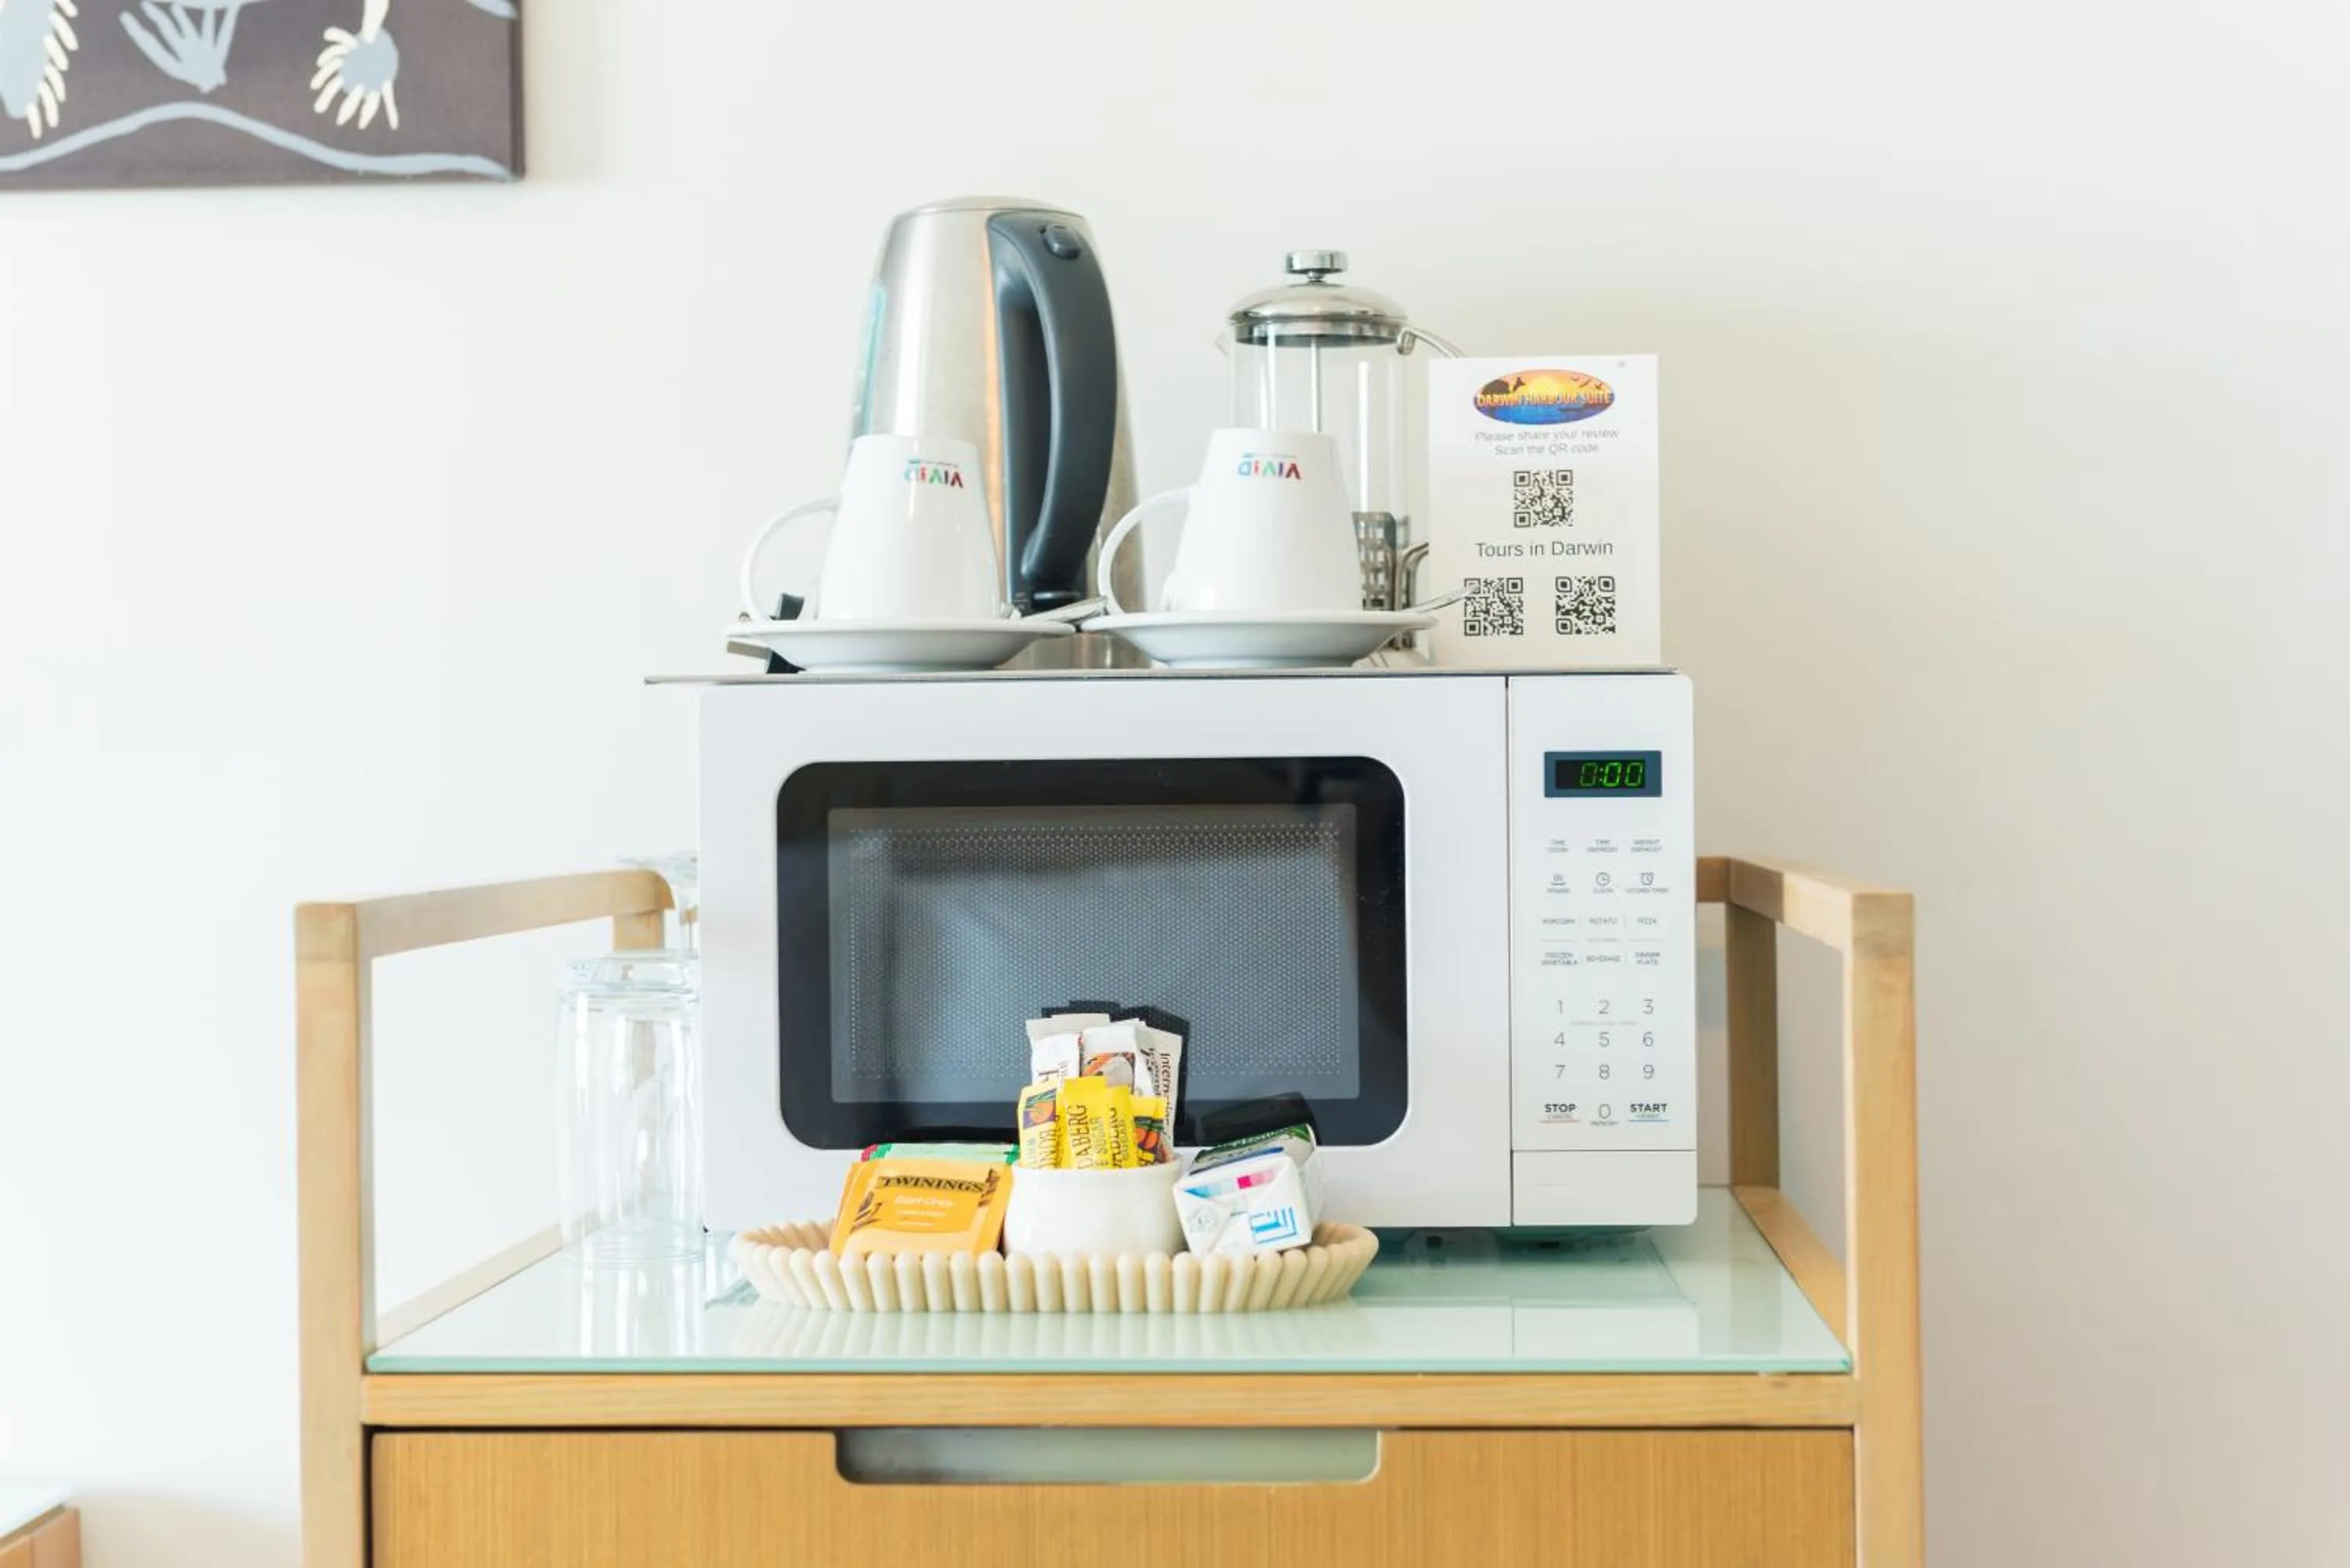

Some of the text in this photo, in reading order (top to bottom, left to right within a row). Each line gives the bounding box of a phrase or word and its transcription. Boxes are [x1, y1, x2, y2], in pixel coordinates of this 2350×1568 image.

[1474, 428, 1619, 443] Please share your review
[1494, 443, 1600, 456] Scan the QR code
[1474, 539, 1614, 558] Tours in Darwin
[1579, 762, 1643, 787] 0:00
[1556, 999, 1564, 1016] 1
[1598, 999, 1611, 1015] 2
[1643, 999, 1654, 1015] 3
[1553, 1032, 1566, 1047] 4
[1598, 1031, 1611, 1048] 5
[1643, 1031, 1654, 1048] 6
[1554, 1064, 1567, 1079] 7
[1598, 1064, 1611, 1080] 8
[1643, 1064, 1655, 1080] 9
[1544, 1103, 1577, 1113] STOP
[1598, 1103, 1611, 1120] 0
[1630, 1103, 1668, 1113] START
[1067, 1104, 1094, 1169] DABERG
[881, 1176, 985, 1193] TWININGS
